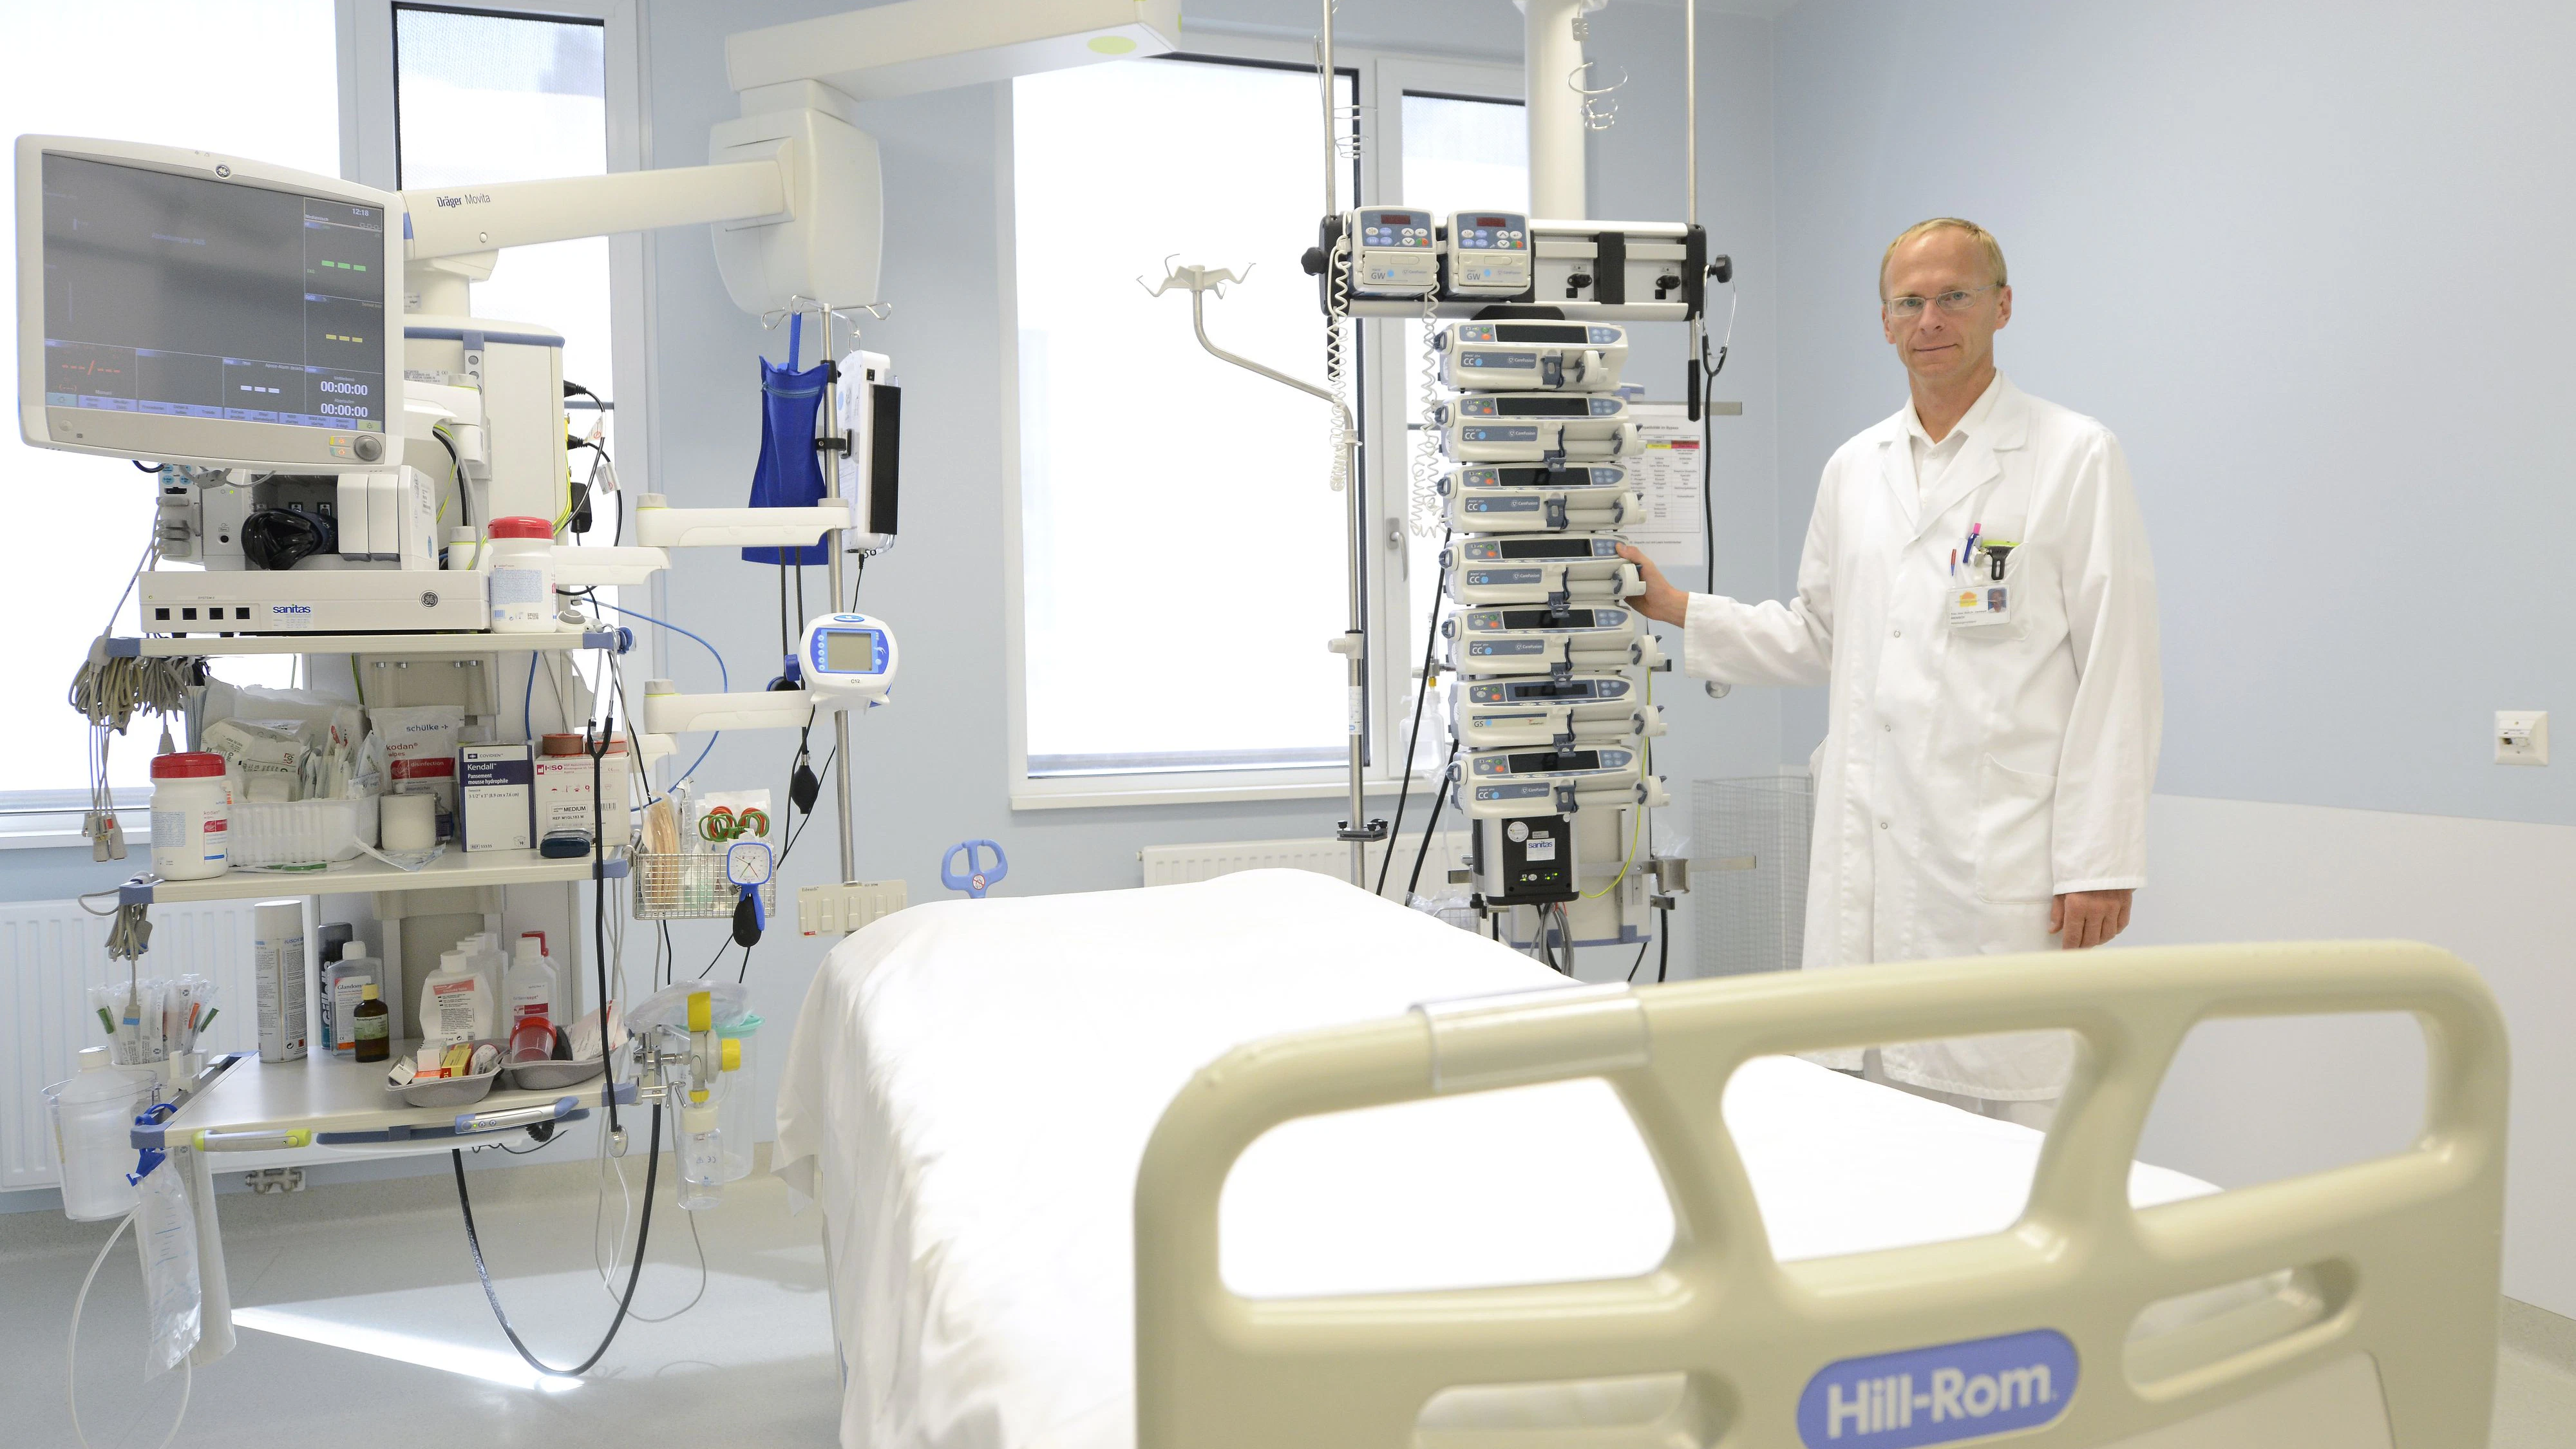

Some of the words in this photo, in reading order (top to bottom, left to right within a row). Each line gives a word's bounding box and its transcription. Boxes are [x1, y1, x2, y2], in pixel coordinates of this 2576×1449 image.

[437, 196, 462, 207] Dräger
[465, 193, 491, 205] Movita
[352, 208, 369, 216] 12:18
[321, 381, 368, 395] 00:00:00
[321, 403, 368, 417] 00:00:00
[273, 604, 310, 613] sanitas
[406, 724, 439, 732] schülke
[1828, 1365, 2052, 1439] Hill-Rom
